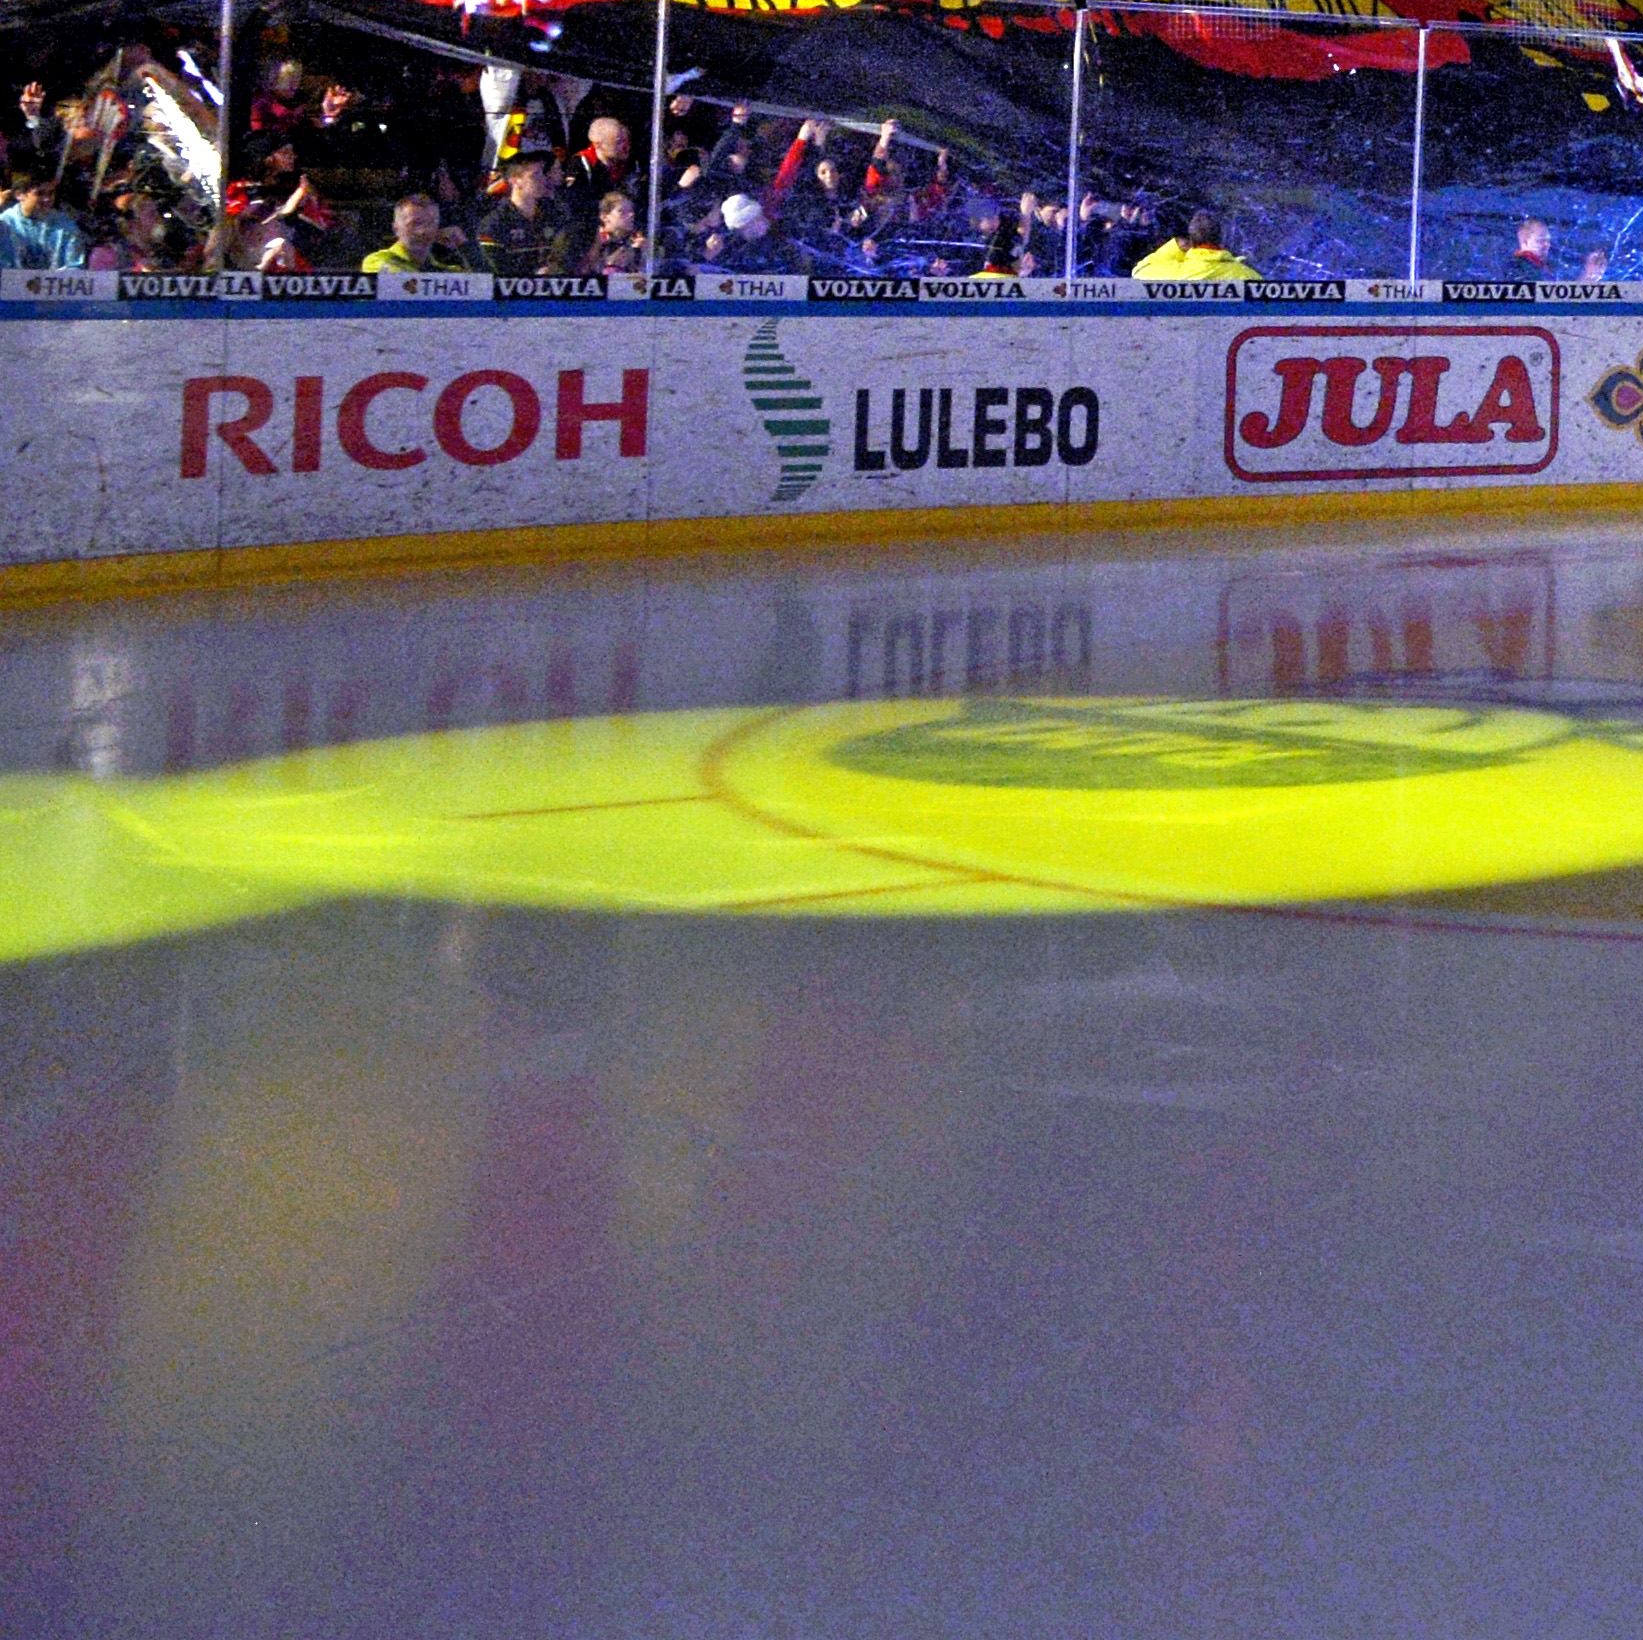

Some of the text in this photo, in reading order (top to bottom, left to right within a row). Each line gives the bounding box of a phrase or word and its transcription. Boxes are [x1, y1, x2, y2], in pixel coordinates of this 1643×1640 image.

[42, 277, 94, 295] THAI
[265, 276, 374, 296] VOLVIA
[421, 279, 469, 295] THAI
[499, 277, 604, 296] VOLVIA
[737, 280, 784, 296] THAI
[811, 279, 916, 298] VOLVIA
[924, 282, 1026, 298] VOLVIA
[1069, 283, 1116, 298] THAI
[1143, 283, 1240, 299] VOLVIA
[1248, 283, 1342, 300] VOLVIA
[1445, 284, 1535, 300] VOLVIA
[1539, 284, 1622, 300] VOLVIA
[1240, 355, 1546, 448] JULA
[179, 368, 649, 479] RICOH
[853, 386, 1100, 472] LULEBO
